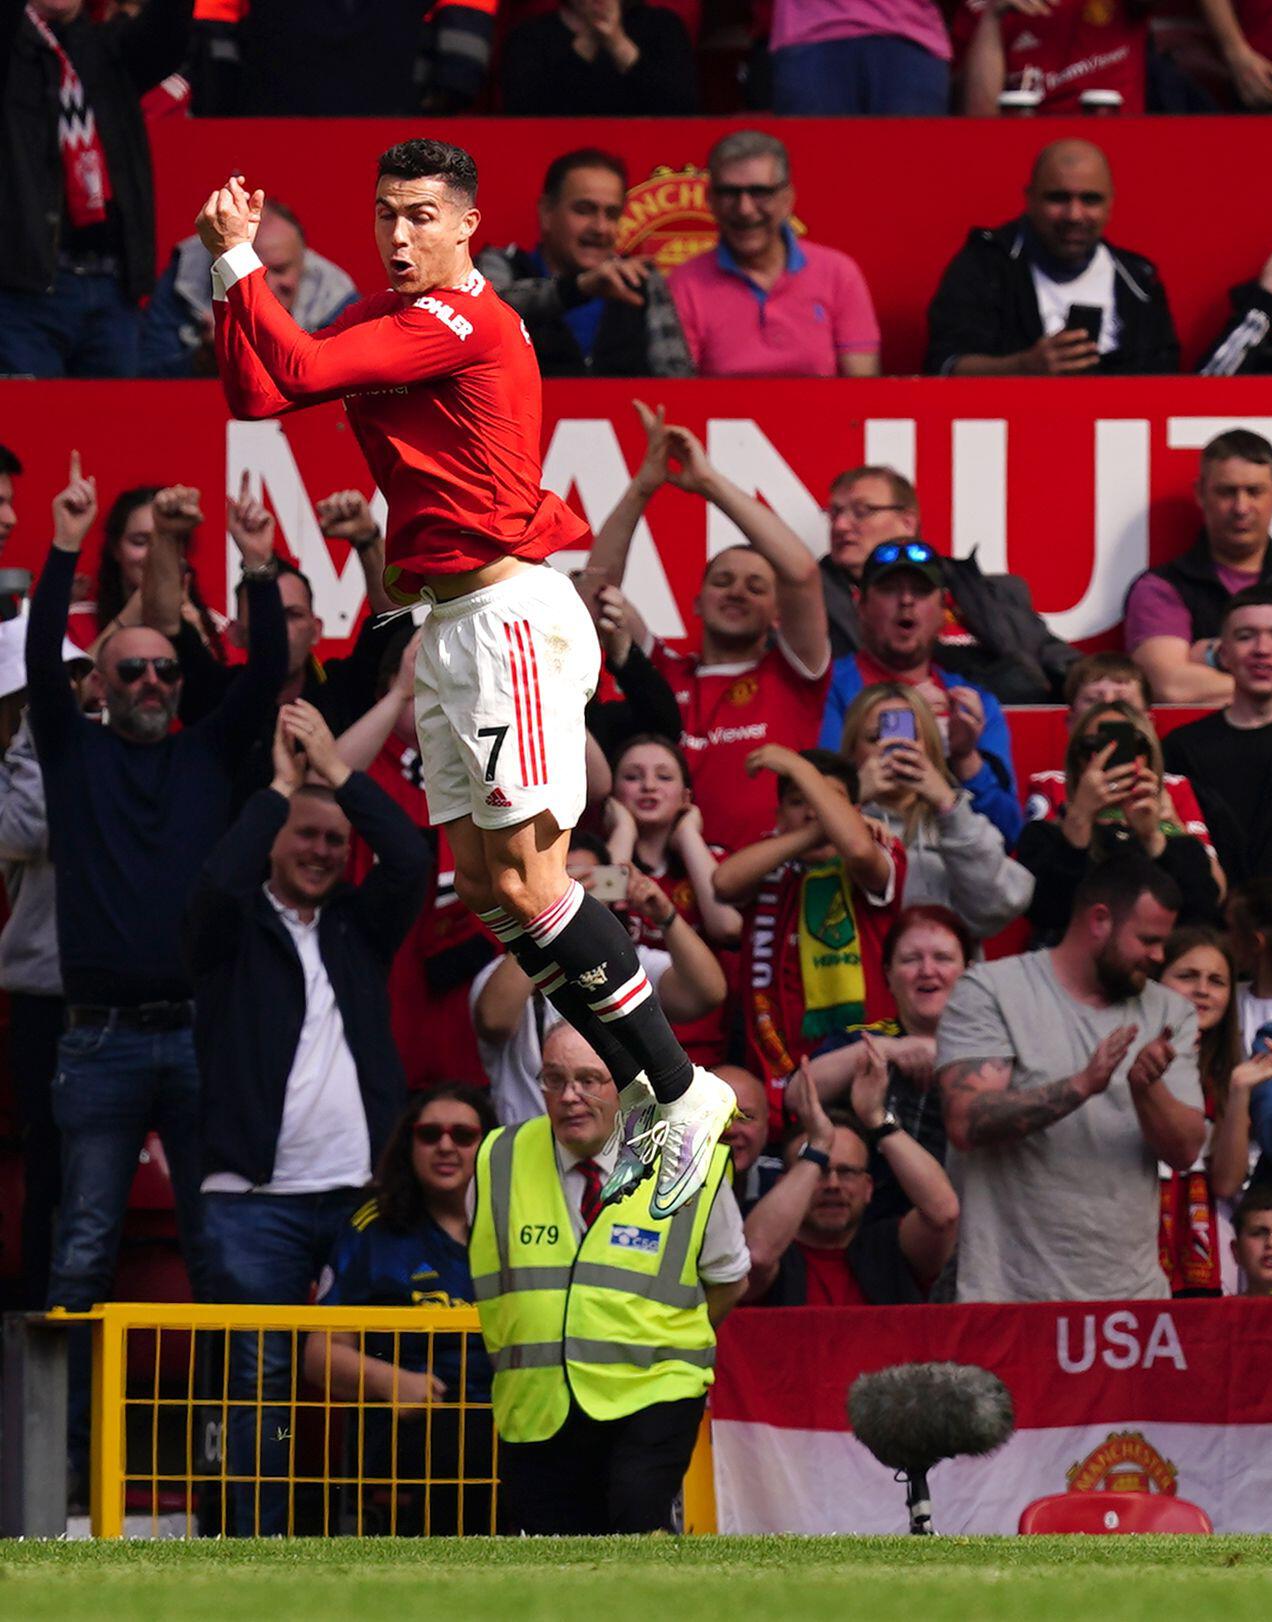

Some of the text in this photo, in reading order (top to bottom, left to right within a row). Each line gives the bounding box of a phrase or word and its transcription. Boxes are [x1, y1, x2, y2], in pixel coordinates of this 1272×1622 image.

[413, 296, 474, 342] OHLER
[477, 724, 510, 782] 7
[519, 1224, 560, 1246] 679
[1056, 1309, 1189, 1374] USA
